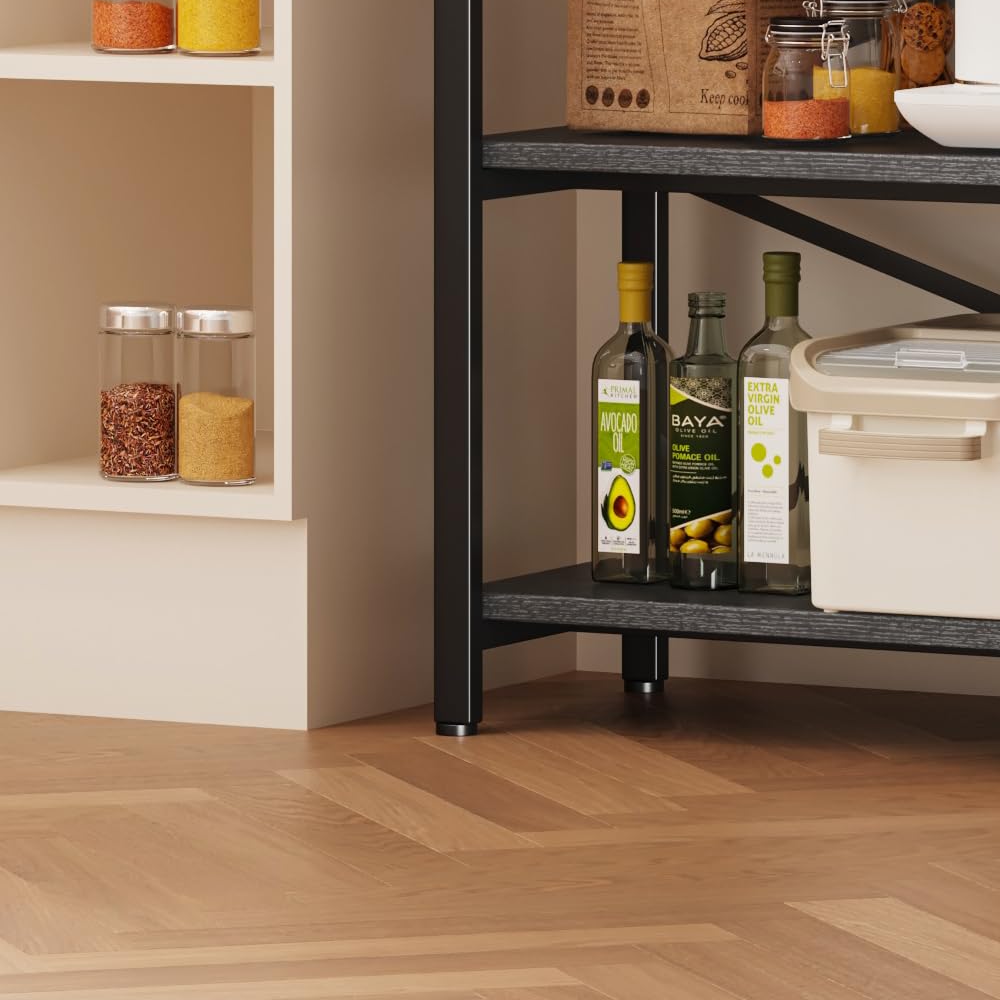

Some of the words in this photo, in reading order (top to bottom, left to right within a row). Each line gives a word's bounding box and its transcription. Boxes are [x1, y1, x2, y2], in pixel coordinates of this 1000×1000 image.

[700, 88, 726, 109] Keep
[610, 384, 637, 393] PRIMAL
[747, 381, 779, 393] EXTRA
[747, 393, 780, 404] VIRGIN
[747, 404, 775, 416] OLIVE
[600, 411, 638, 434] AVOCADO
[671, 414, 725, 428] BAYA
[747, 415, 763, 426] OIL
[612, 431, 625, 453] OIL
[671, 443, 690, 453] OLIVE
[671, 452, 702, 461] POMACE
[703, 453, 721, 461] OIL
